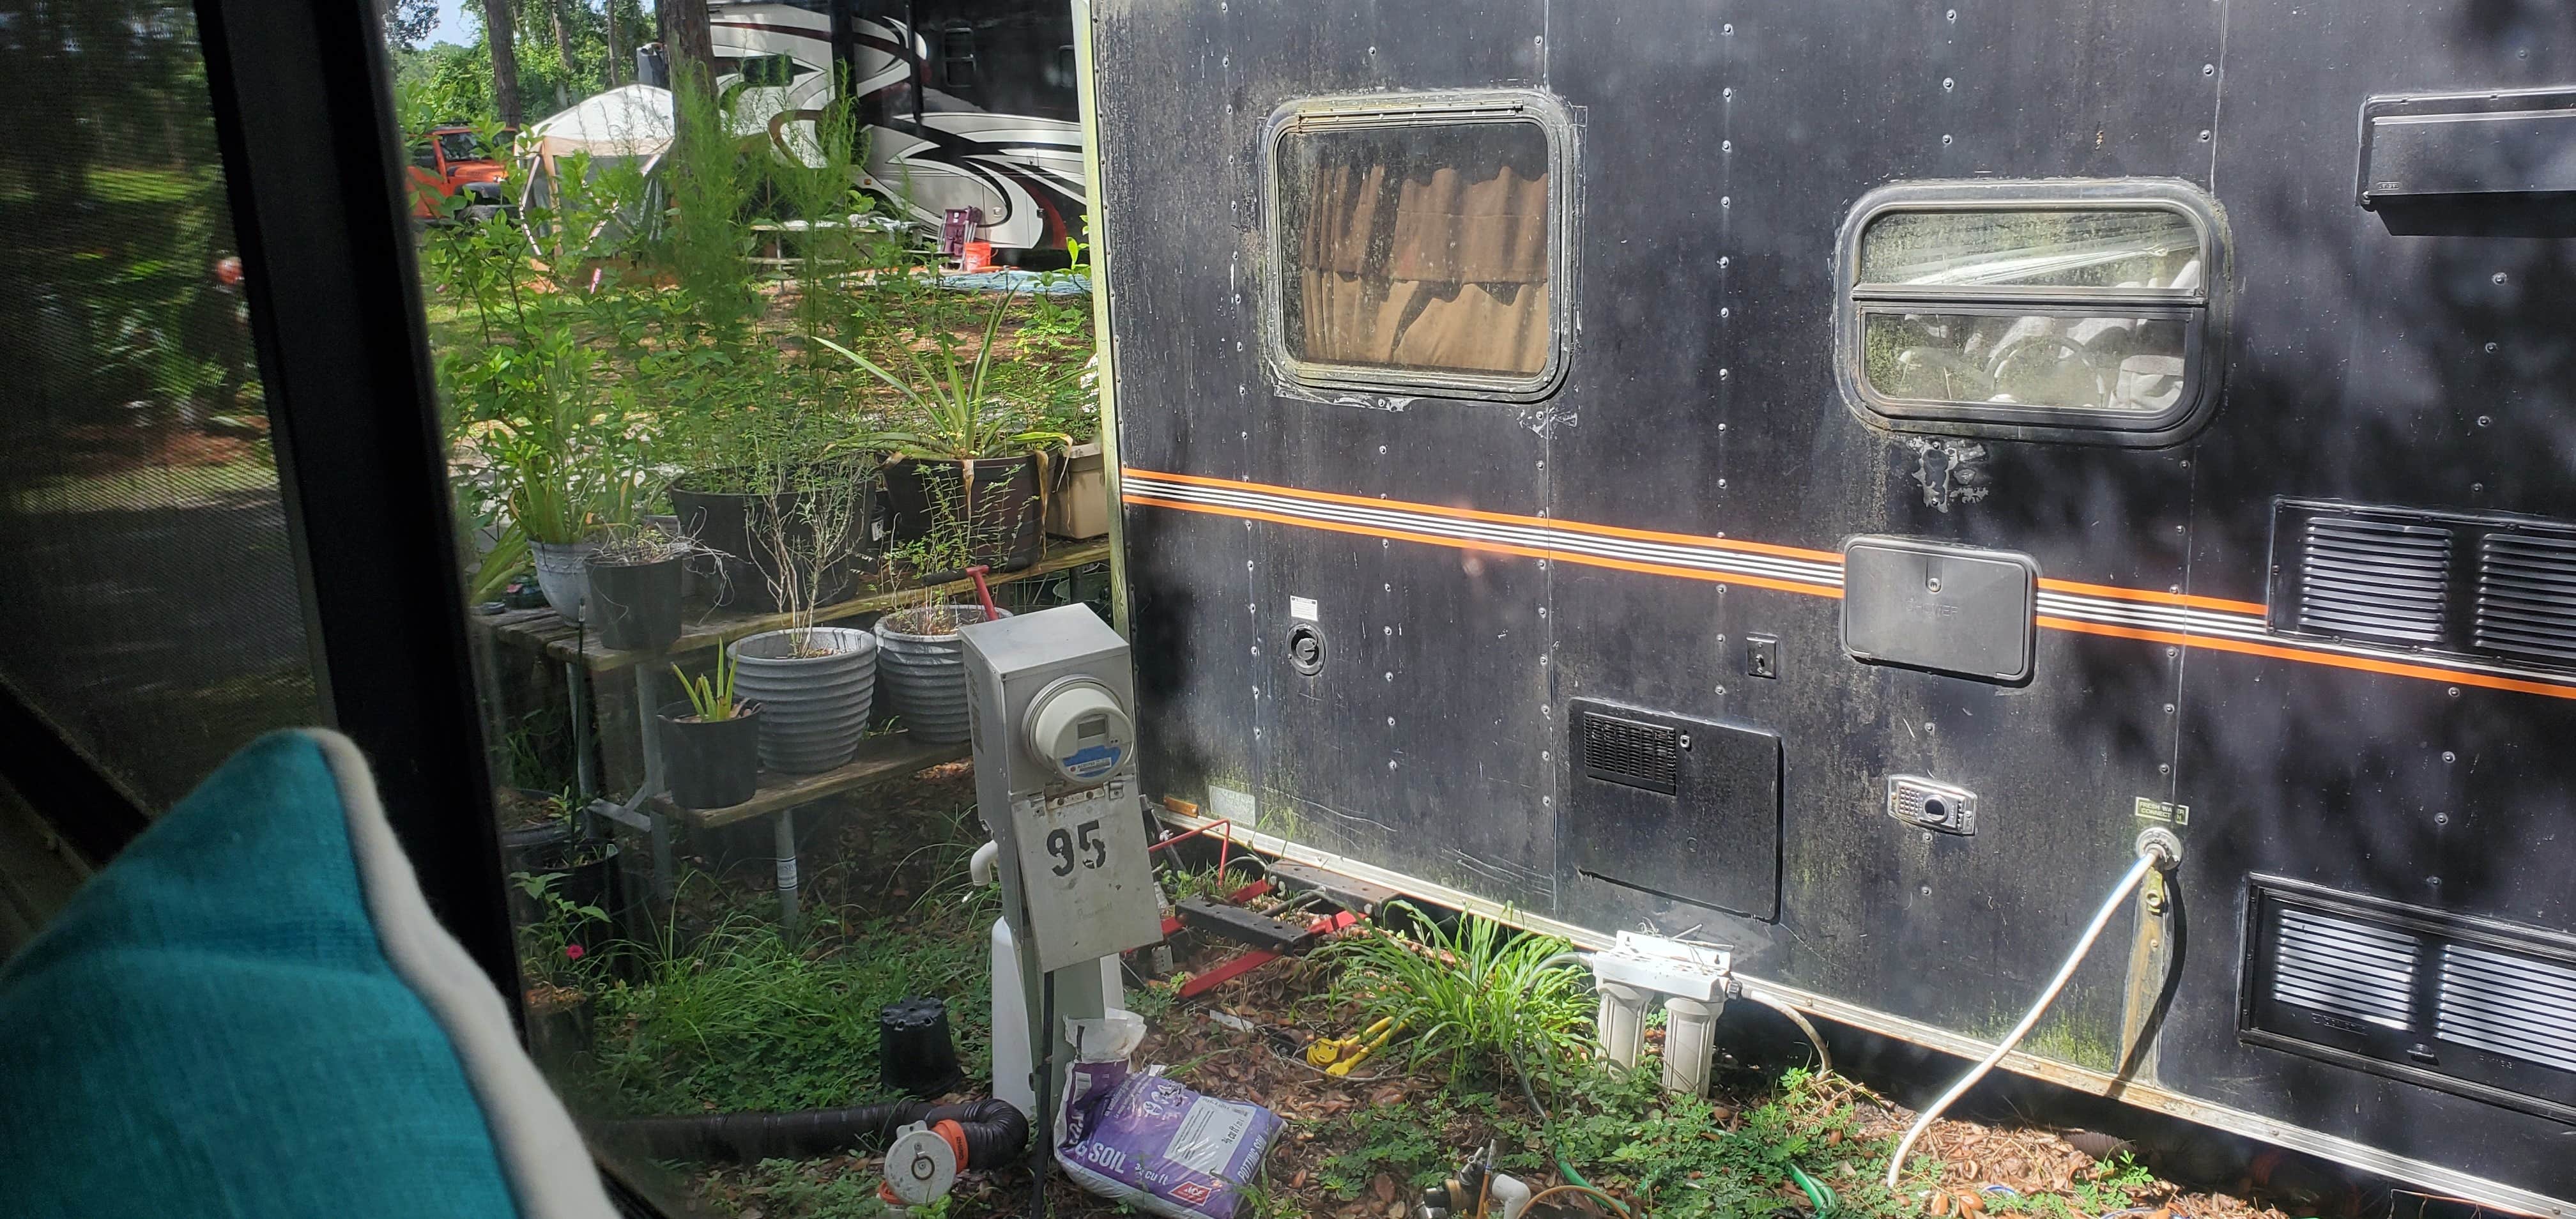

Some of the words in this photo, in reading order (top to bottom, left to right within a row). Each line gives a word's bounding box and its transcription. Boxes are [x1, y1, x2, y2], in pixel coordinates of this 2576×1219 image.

[2161, 806, 2184, 815] WAER
[1046, 820, 1107, 877] 95
[1088, 1142, 1127, 1174] SOIL
[1237, 1147, 1261, 1183] POTTING
[1253, 1134, 1267, 1153] SOIL
[1144, 1170, 1156, 1181] cu
[1158, 1174, 1169, 1186] ft
[1183, 1186, 1205, 1197] ACE
